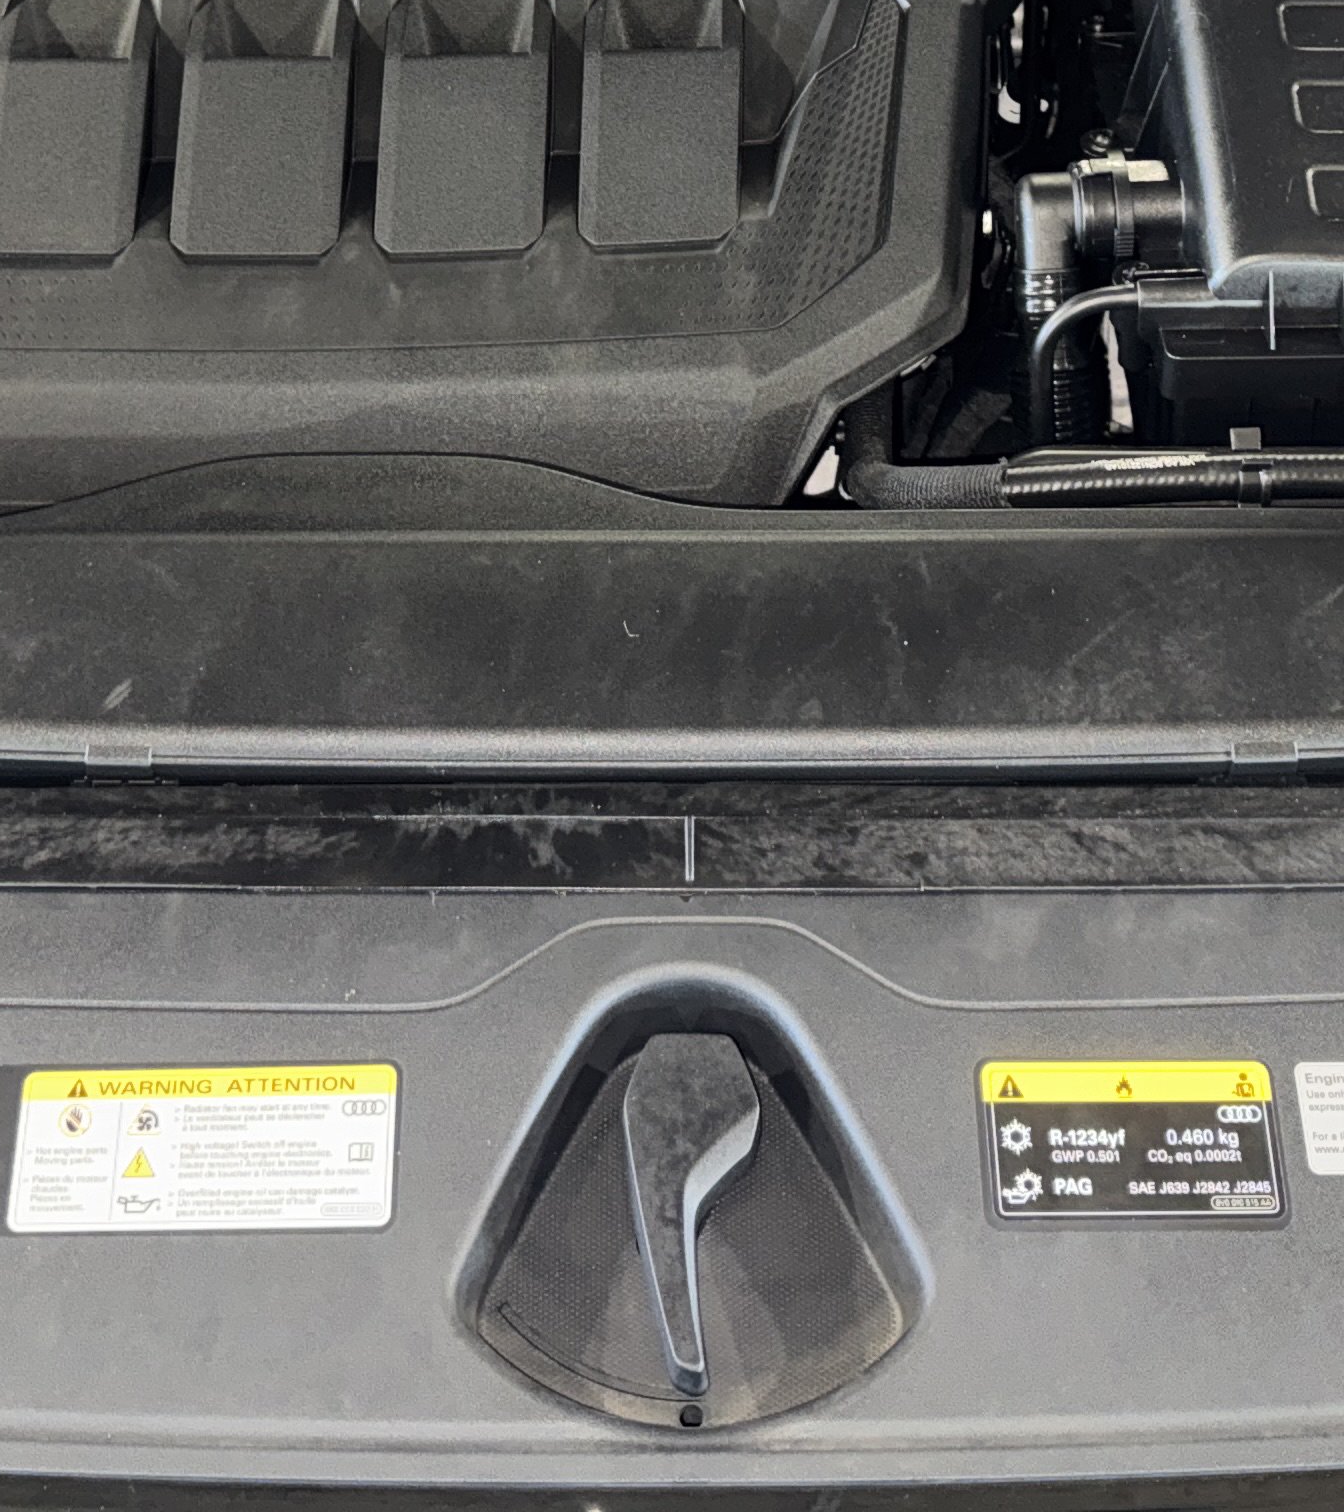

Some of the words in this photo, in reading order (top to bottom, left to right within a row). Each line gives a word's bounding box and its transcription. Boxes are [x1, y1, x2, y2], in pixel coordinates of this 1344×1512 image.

[98, 1079, 212, 1096] WARNING
[226, 1076, 356, 1093] ATTENTION
[1306, 1090, 1325, 1099] Use
[1047, 1128, 1126, 1149] R-1234yf
[1165, 1128, 1214, 1146] 0.460
[1217, 1128, 1240, 1149] kg
[1312, 1131, 1329, 1141] For
[1051, 1150, 1084, 1163] GWP
[1086, 1149, 1121, 1163] 0.501
[1175, 1152, 1193, 1165] eq
[1194, 1149, 1242, 1163] 0.0002t
[1053, 1178, 1094, 1196] PAG
[1128, 1182, 1156, 1195] SAE
[1159, 1181, 1190, 1195] J639
[1192, 1181, 1230, 1195] J2842
[1233, 1181, 1272, 1194] J2845
